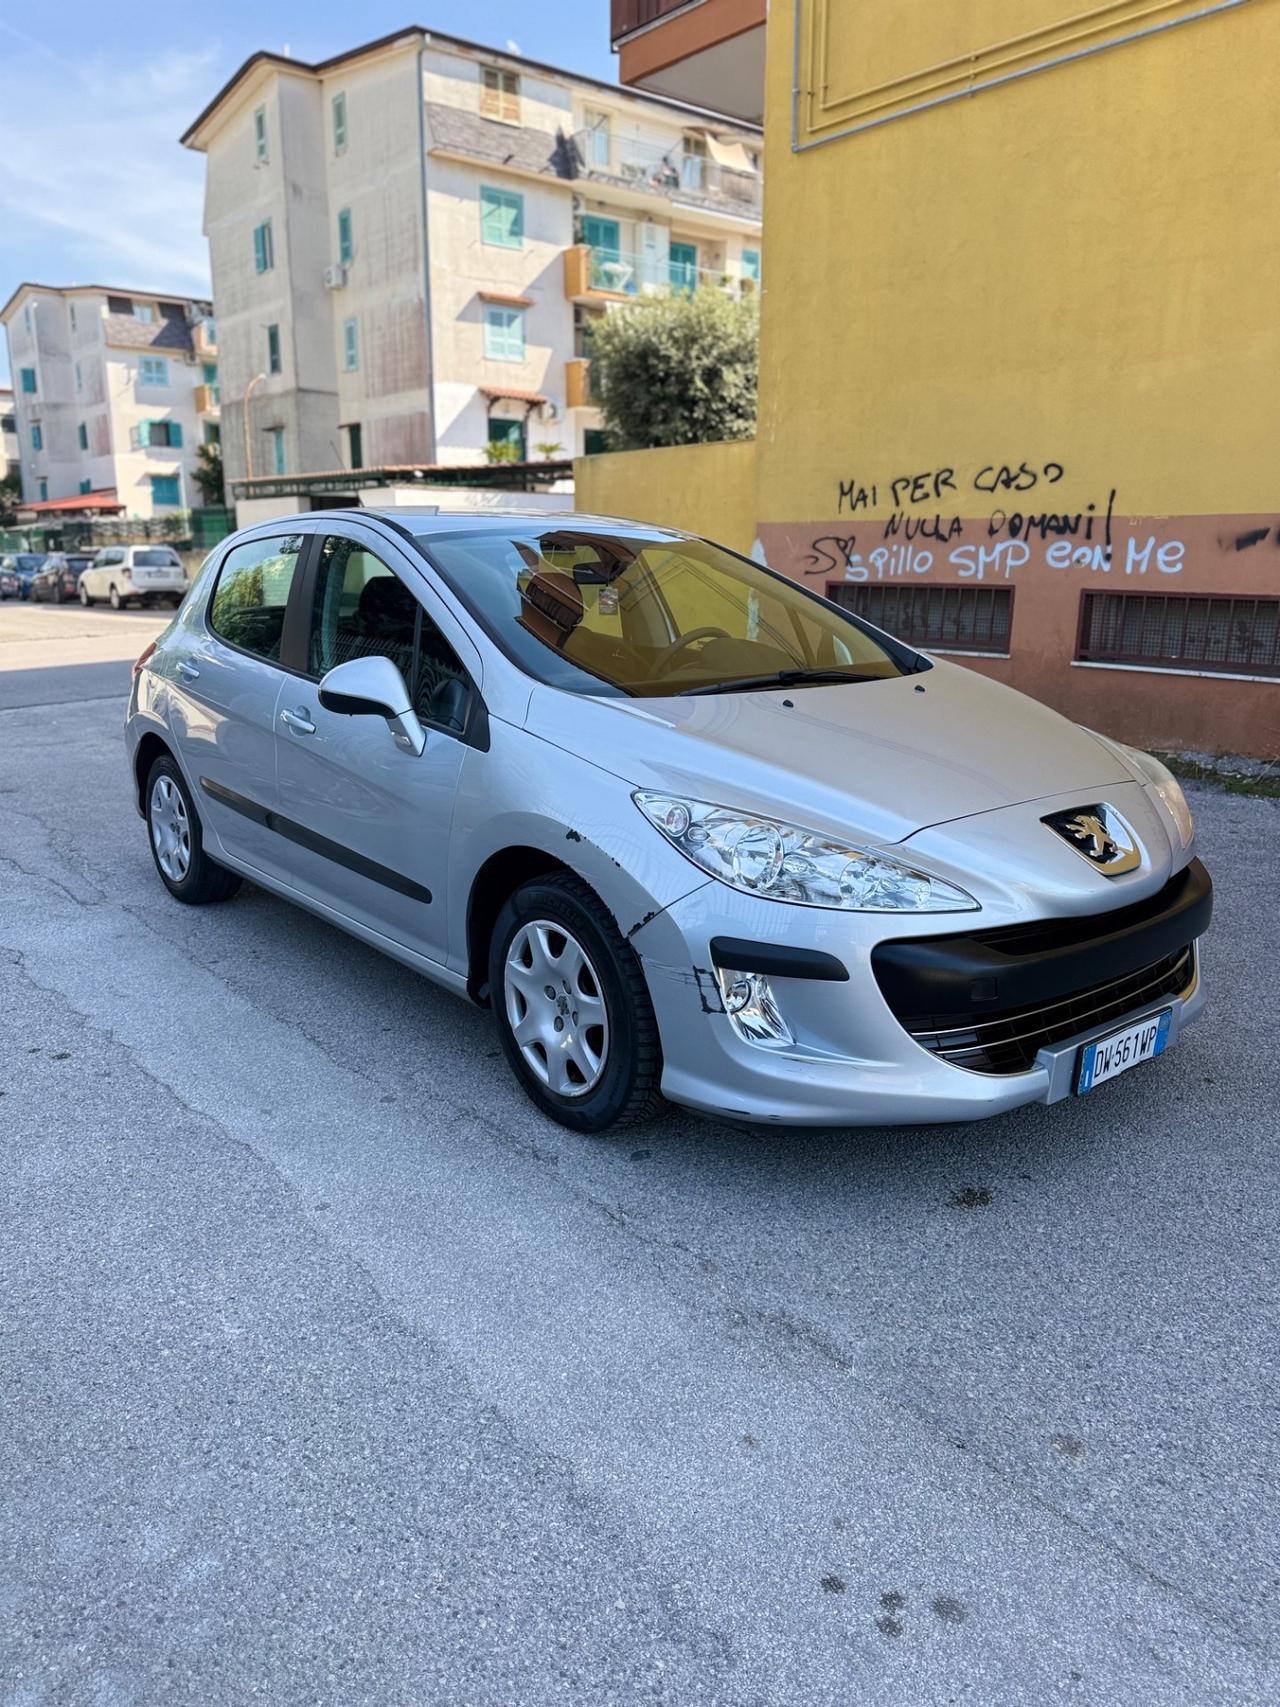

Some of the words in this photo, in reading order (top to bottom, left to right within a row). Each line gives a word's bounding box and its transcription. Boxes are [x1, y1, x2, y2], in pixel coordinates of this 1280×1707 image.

[838, 479, 877, 514] MAI
[891, 467, 957, 507] PER
[974, 462, 1064, 493] CASO
